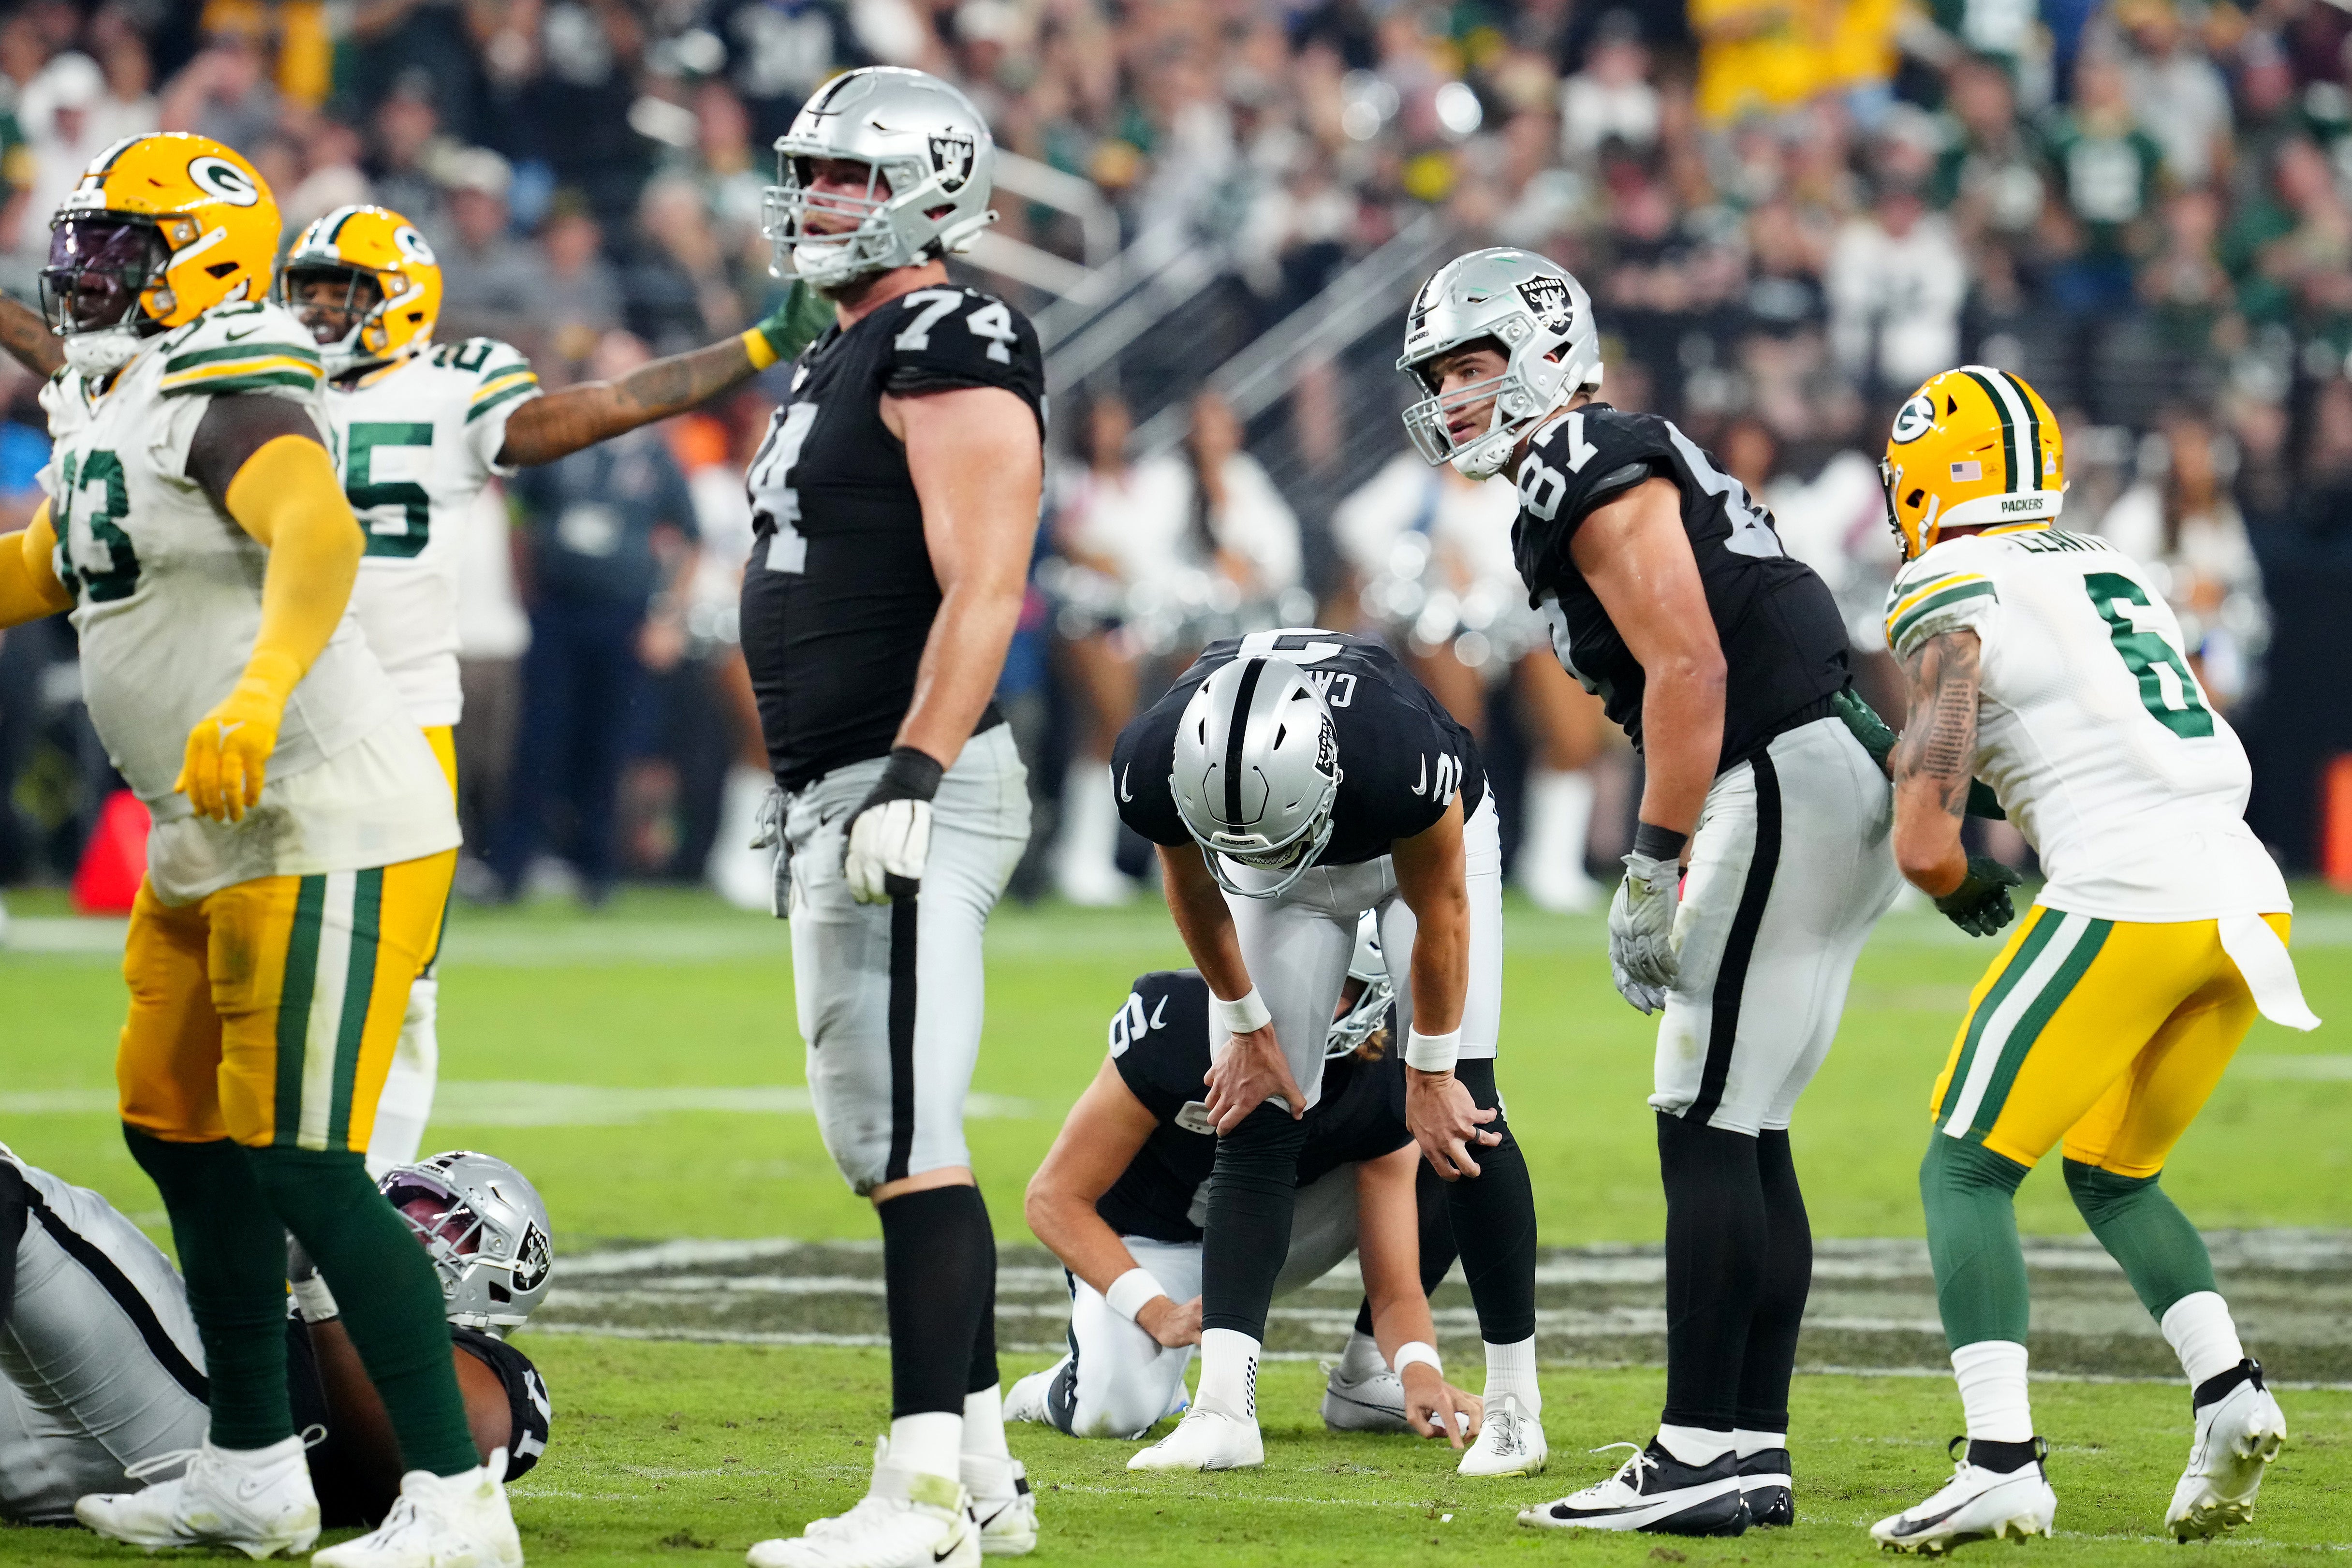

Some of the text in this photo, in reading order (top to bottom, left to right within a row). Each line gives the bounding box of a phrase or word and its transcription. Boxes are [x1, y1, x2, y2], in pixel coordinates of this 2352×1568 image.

[1521, 279, 1562, 292] RAIDERS
[894, 289, 1018, 366] 74
[331, 422, 434, 558] 5
[746, 401, 820, 575] 4
[1516, 411, 1599, 522] 87
[2001, 498, 2043, 513] PACKERS
[2084, 572, 2215, 739] 6
[1306, 670, 1357, 708] CA
[1317, 717, 1328, 765] RAIDERS
[1220, 837, 1256, 846] RAIDERS
